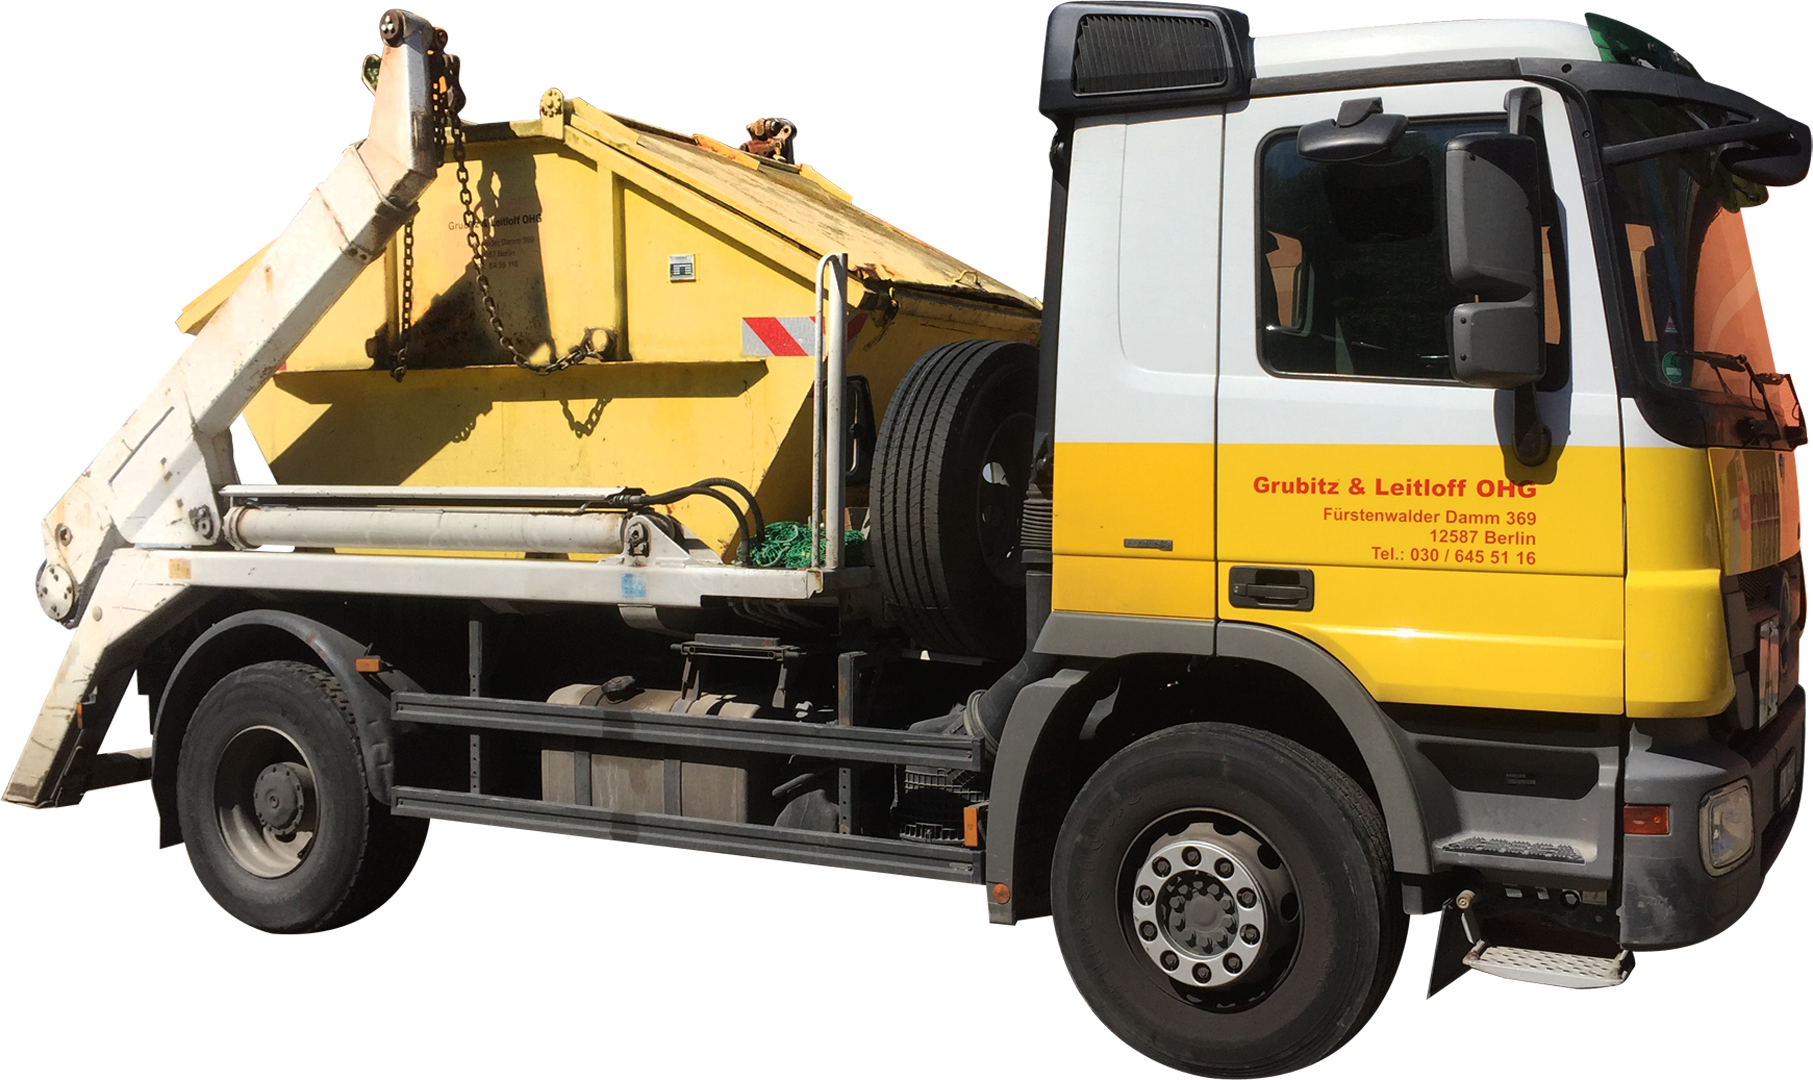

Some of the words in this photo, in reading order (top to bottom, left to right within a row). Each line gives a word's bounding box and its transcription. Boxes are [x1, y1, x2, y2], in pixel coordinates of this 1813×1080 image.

[522, 213, 541, 224] OHG
[1253, 476, 1339, 495] Grubitz
[1348, 477, 1366, 496] &
[1375, 478, 1467, 497] Leitloff
[1476, 479, 1537, 499] OHG
[1323, 507, 1440, 524] Fürstenwalder
[1445, 509, 1500, 525] Damm
[1506, 511, 1537, 526] 369
[1430, 529, 1478, 544] 12587
[1484, 530, 1536, 546] Berlin
[1372, 546, 1405, 561] Tel.:
[1410, 547, 1439, 562] 030
[1444, 549, 1451, 562] /
[1454, 549, 1485, 564] 645
[1491, 550, 1509, 564] 51
[1517, 551, 1536, 566] 16
